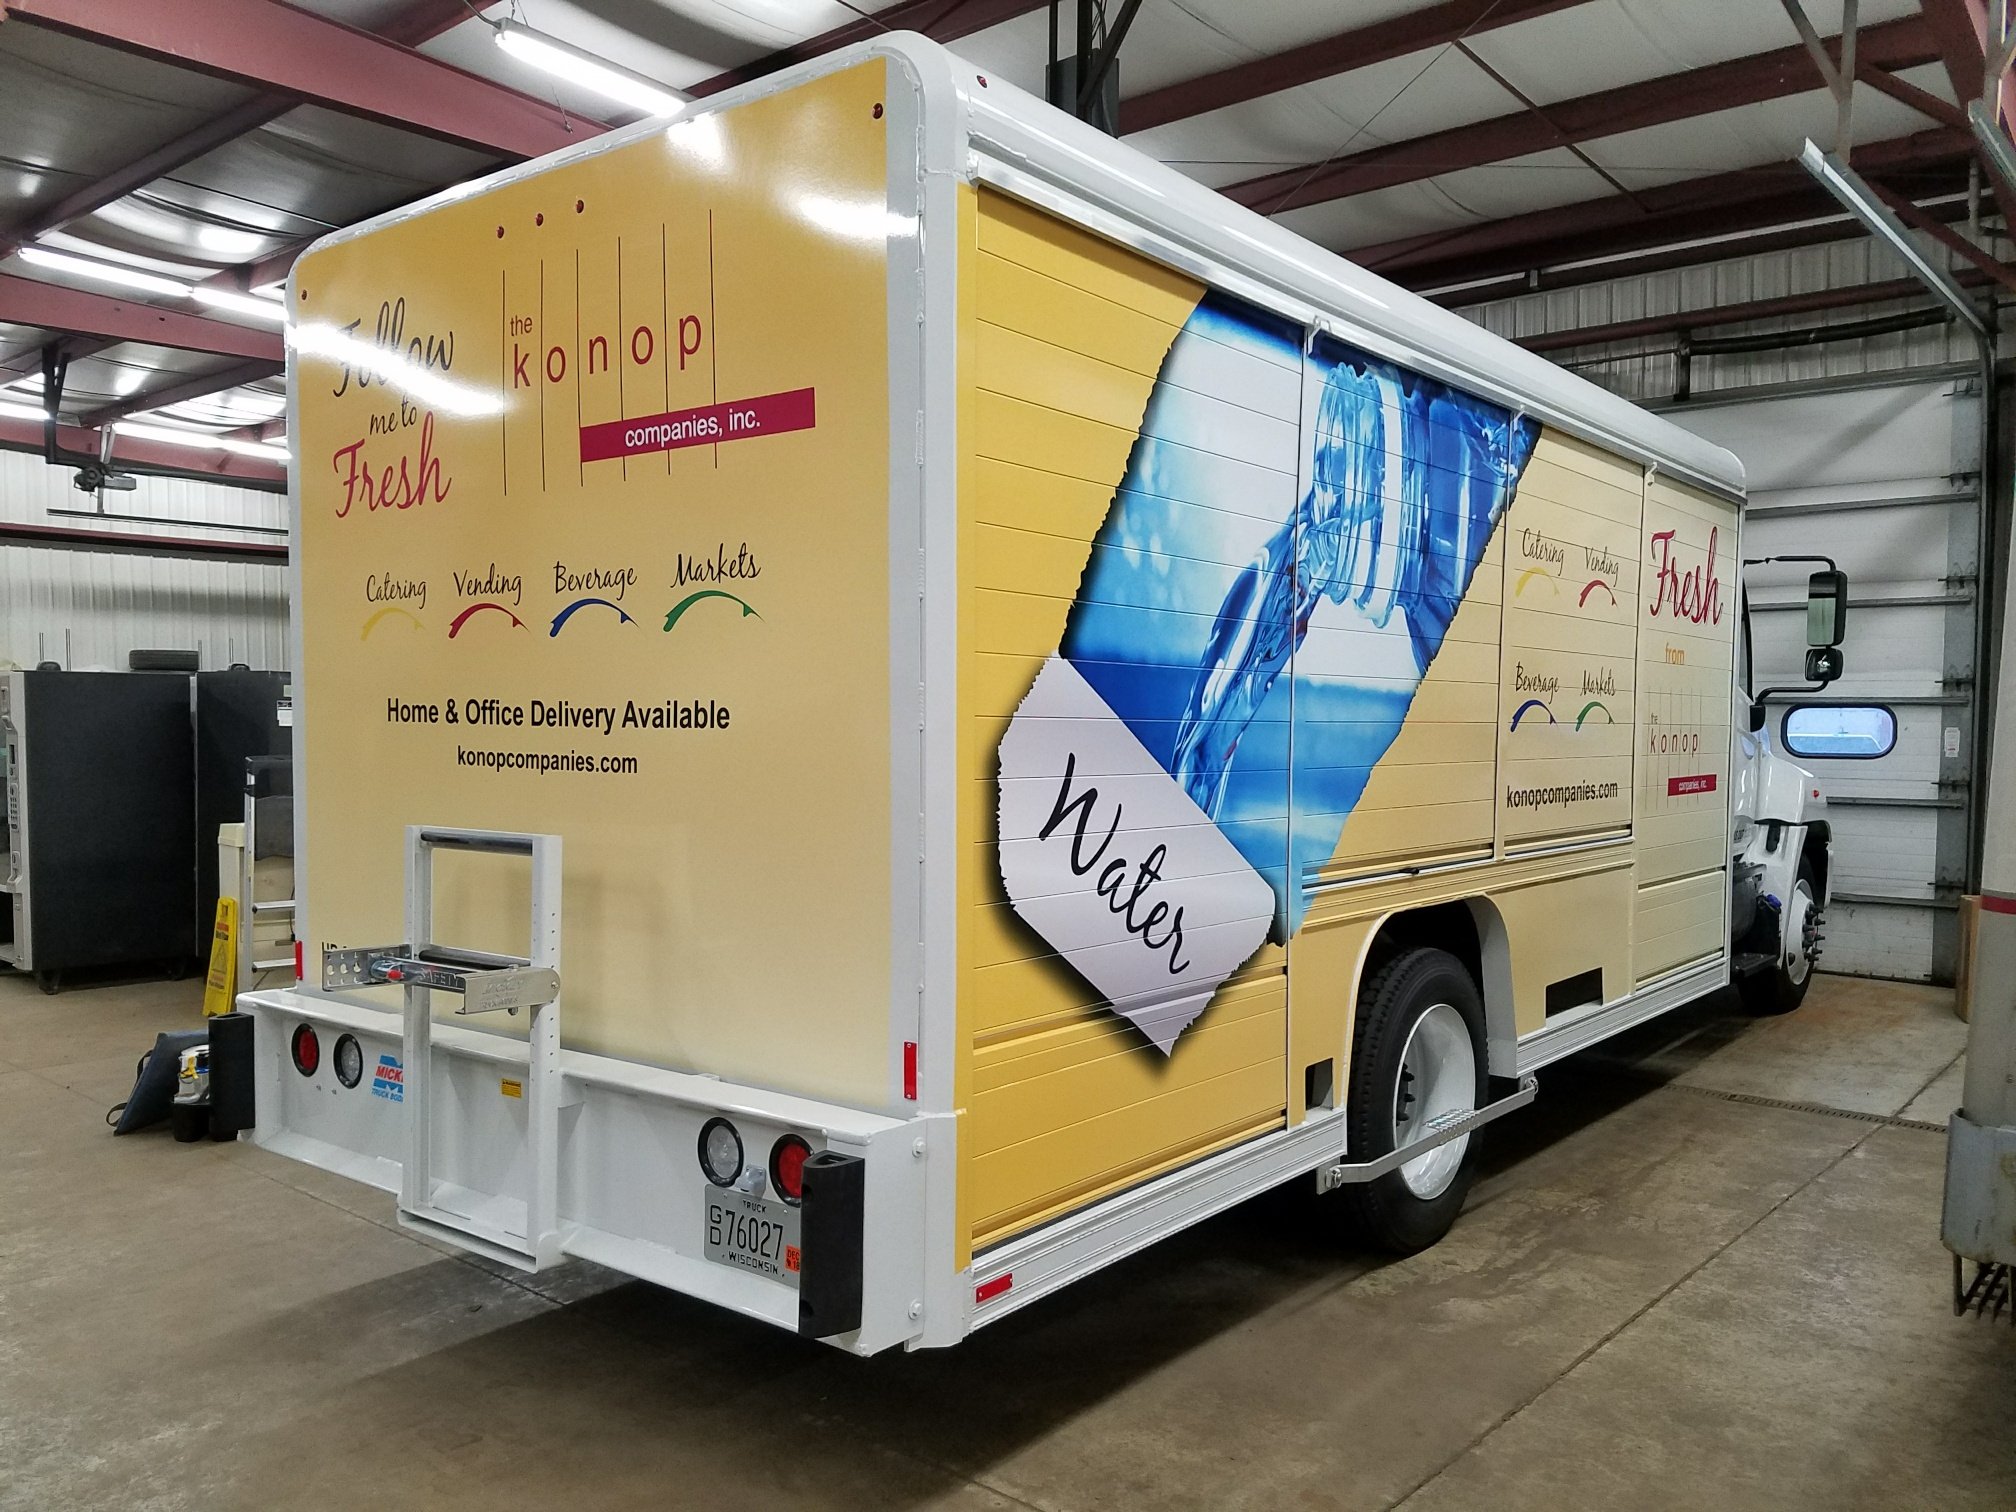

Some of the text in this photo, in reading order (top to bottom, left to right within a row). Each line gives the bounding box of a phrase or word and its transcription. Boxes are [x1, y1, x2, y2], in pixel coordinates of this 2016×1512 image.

[510, 315, 532, 336] the
[513, 315, 701, 389] konop
[370, 392, 417, 435] me to
[625, 408, 760, 447] companies, inc.
[333, 411, 452, 518] Fresh
[366, 542, 761, 610] Catering Vending Beverage Markets
[1522, 528, 1619, 587] Catering Vending
[1650, 526, 1723, 625] Fresh
[1665, 643, 1684, 665] from
[1515, 661, 1616, 705] Beverage Markets
[388, 698, 730, 735] Home & Office Delivery Available
[457, 745, 638, 775] konopcompanies.com
[1651, 727, 1698, 758] konop
[1507, 779, 1618, 811] konopcompanies.com
[1038, 752, 1190, 974] Water
[743, 1200, 766, 1213] TRUCK
[725, 1209, 783, 1260] 76027
[728, 1250, 779, 1274] WISCONSIN
[787, 1249, 800, 1261] DEC
